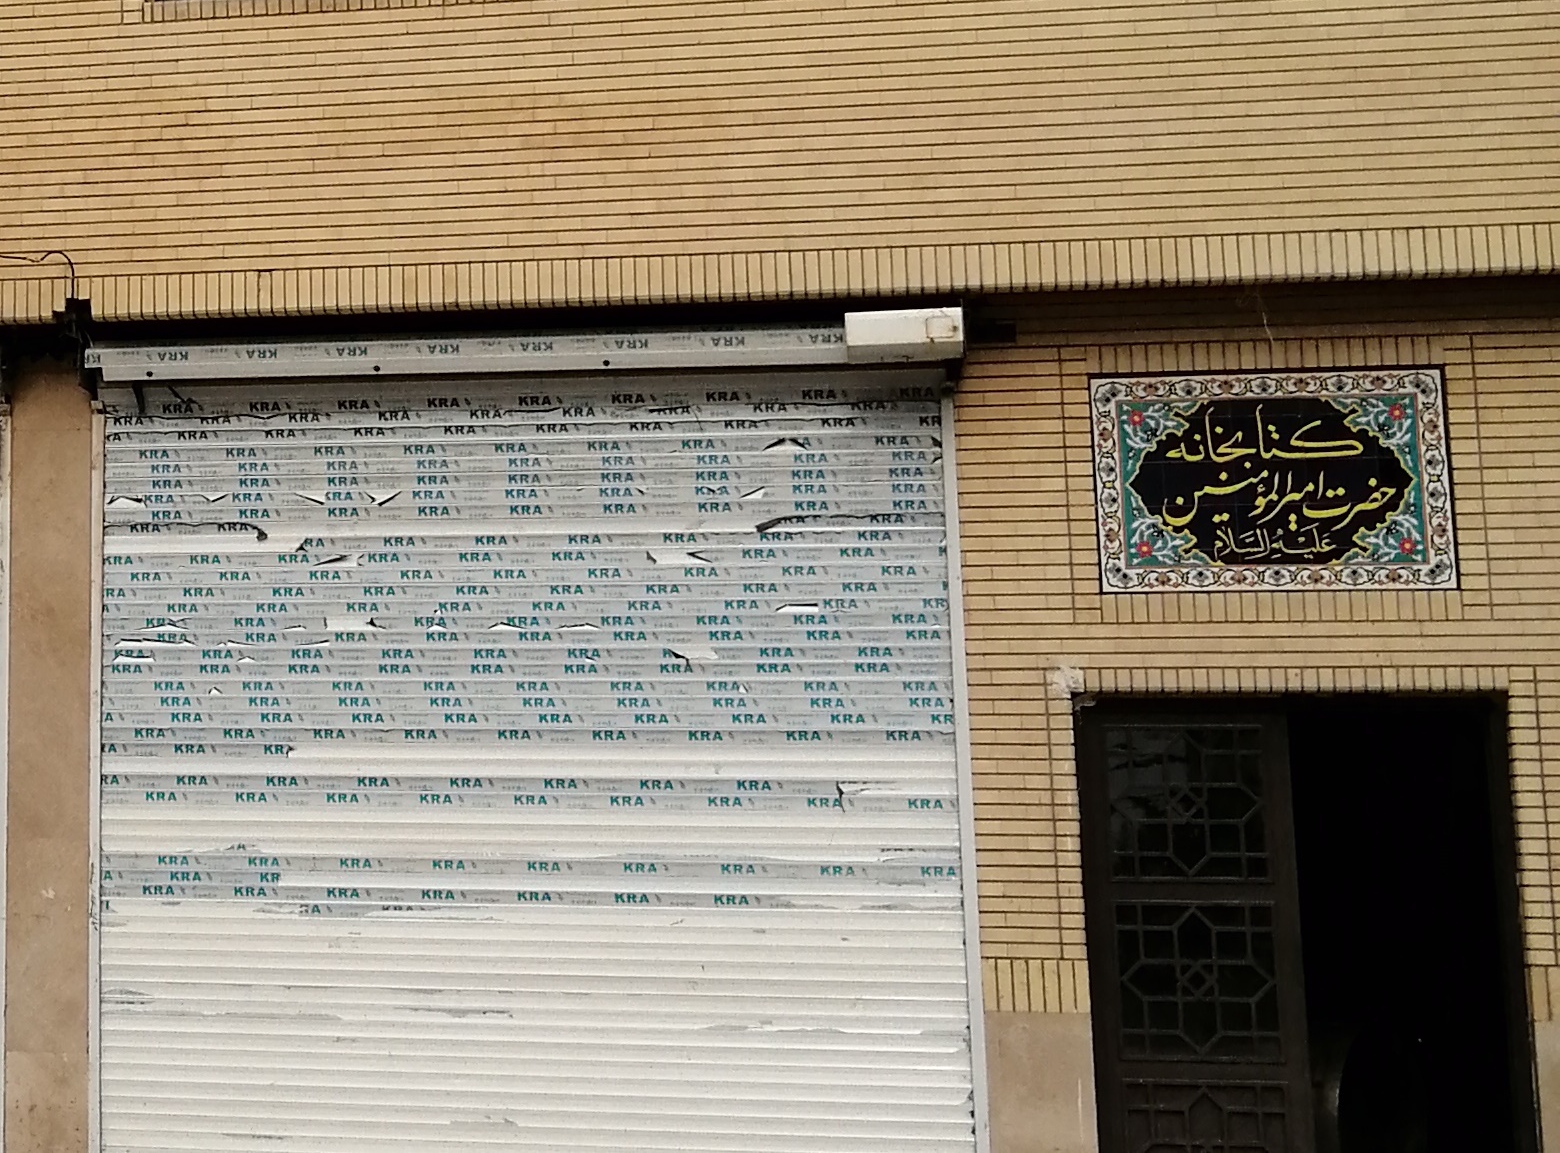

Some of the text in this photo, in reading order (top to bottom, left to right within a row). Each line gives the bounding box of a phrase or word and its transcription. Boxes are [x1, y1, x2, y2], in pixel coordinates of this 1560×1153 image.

[249, 400, 282, 412] KRA
[338, 398, 370, 410] KRA
[611, 392, 646, 404] KRA
[705, 390, 741, 402] KRA
[802, 387, 837, 400] KRA
[1166, 403, 1364, 470] کتابخانه
[152, 466, 924, 489] KRA KRA KRA KRA KRA KRA KRA KRA KRA
[1302, 476, 1397, 532] حضرت
[130, 564, 917, 582] KRA KRA KRA KRA KRA KRA KRA KRA KRA
[160, 695, 945, 709] KRA KRA KRA KRA KRA KRA KRA KRA KRA
[176, 773, 772, 791] KRA KRA KRA KRA KRA KRA KRA
[143, 883, 749, 906] KRA KRA KRA KRA KRA KRA KRA
